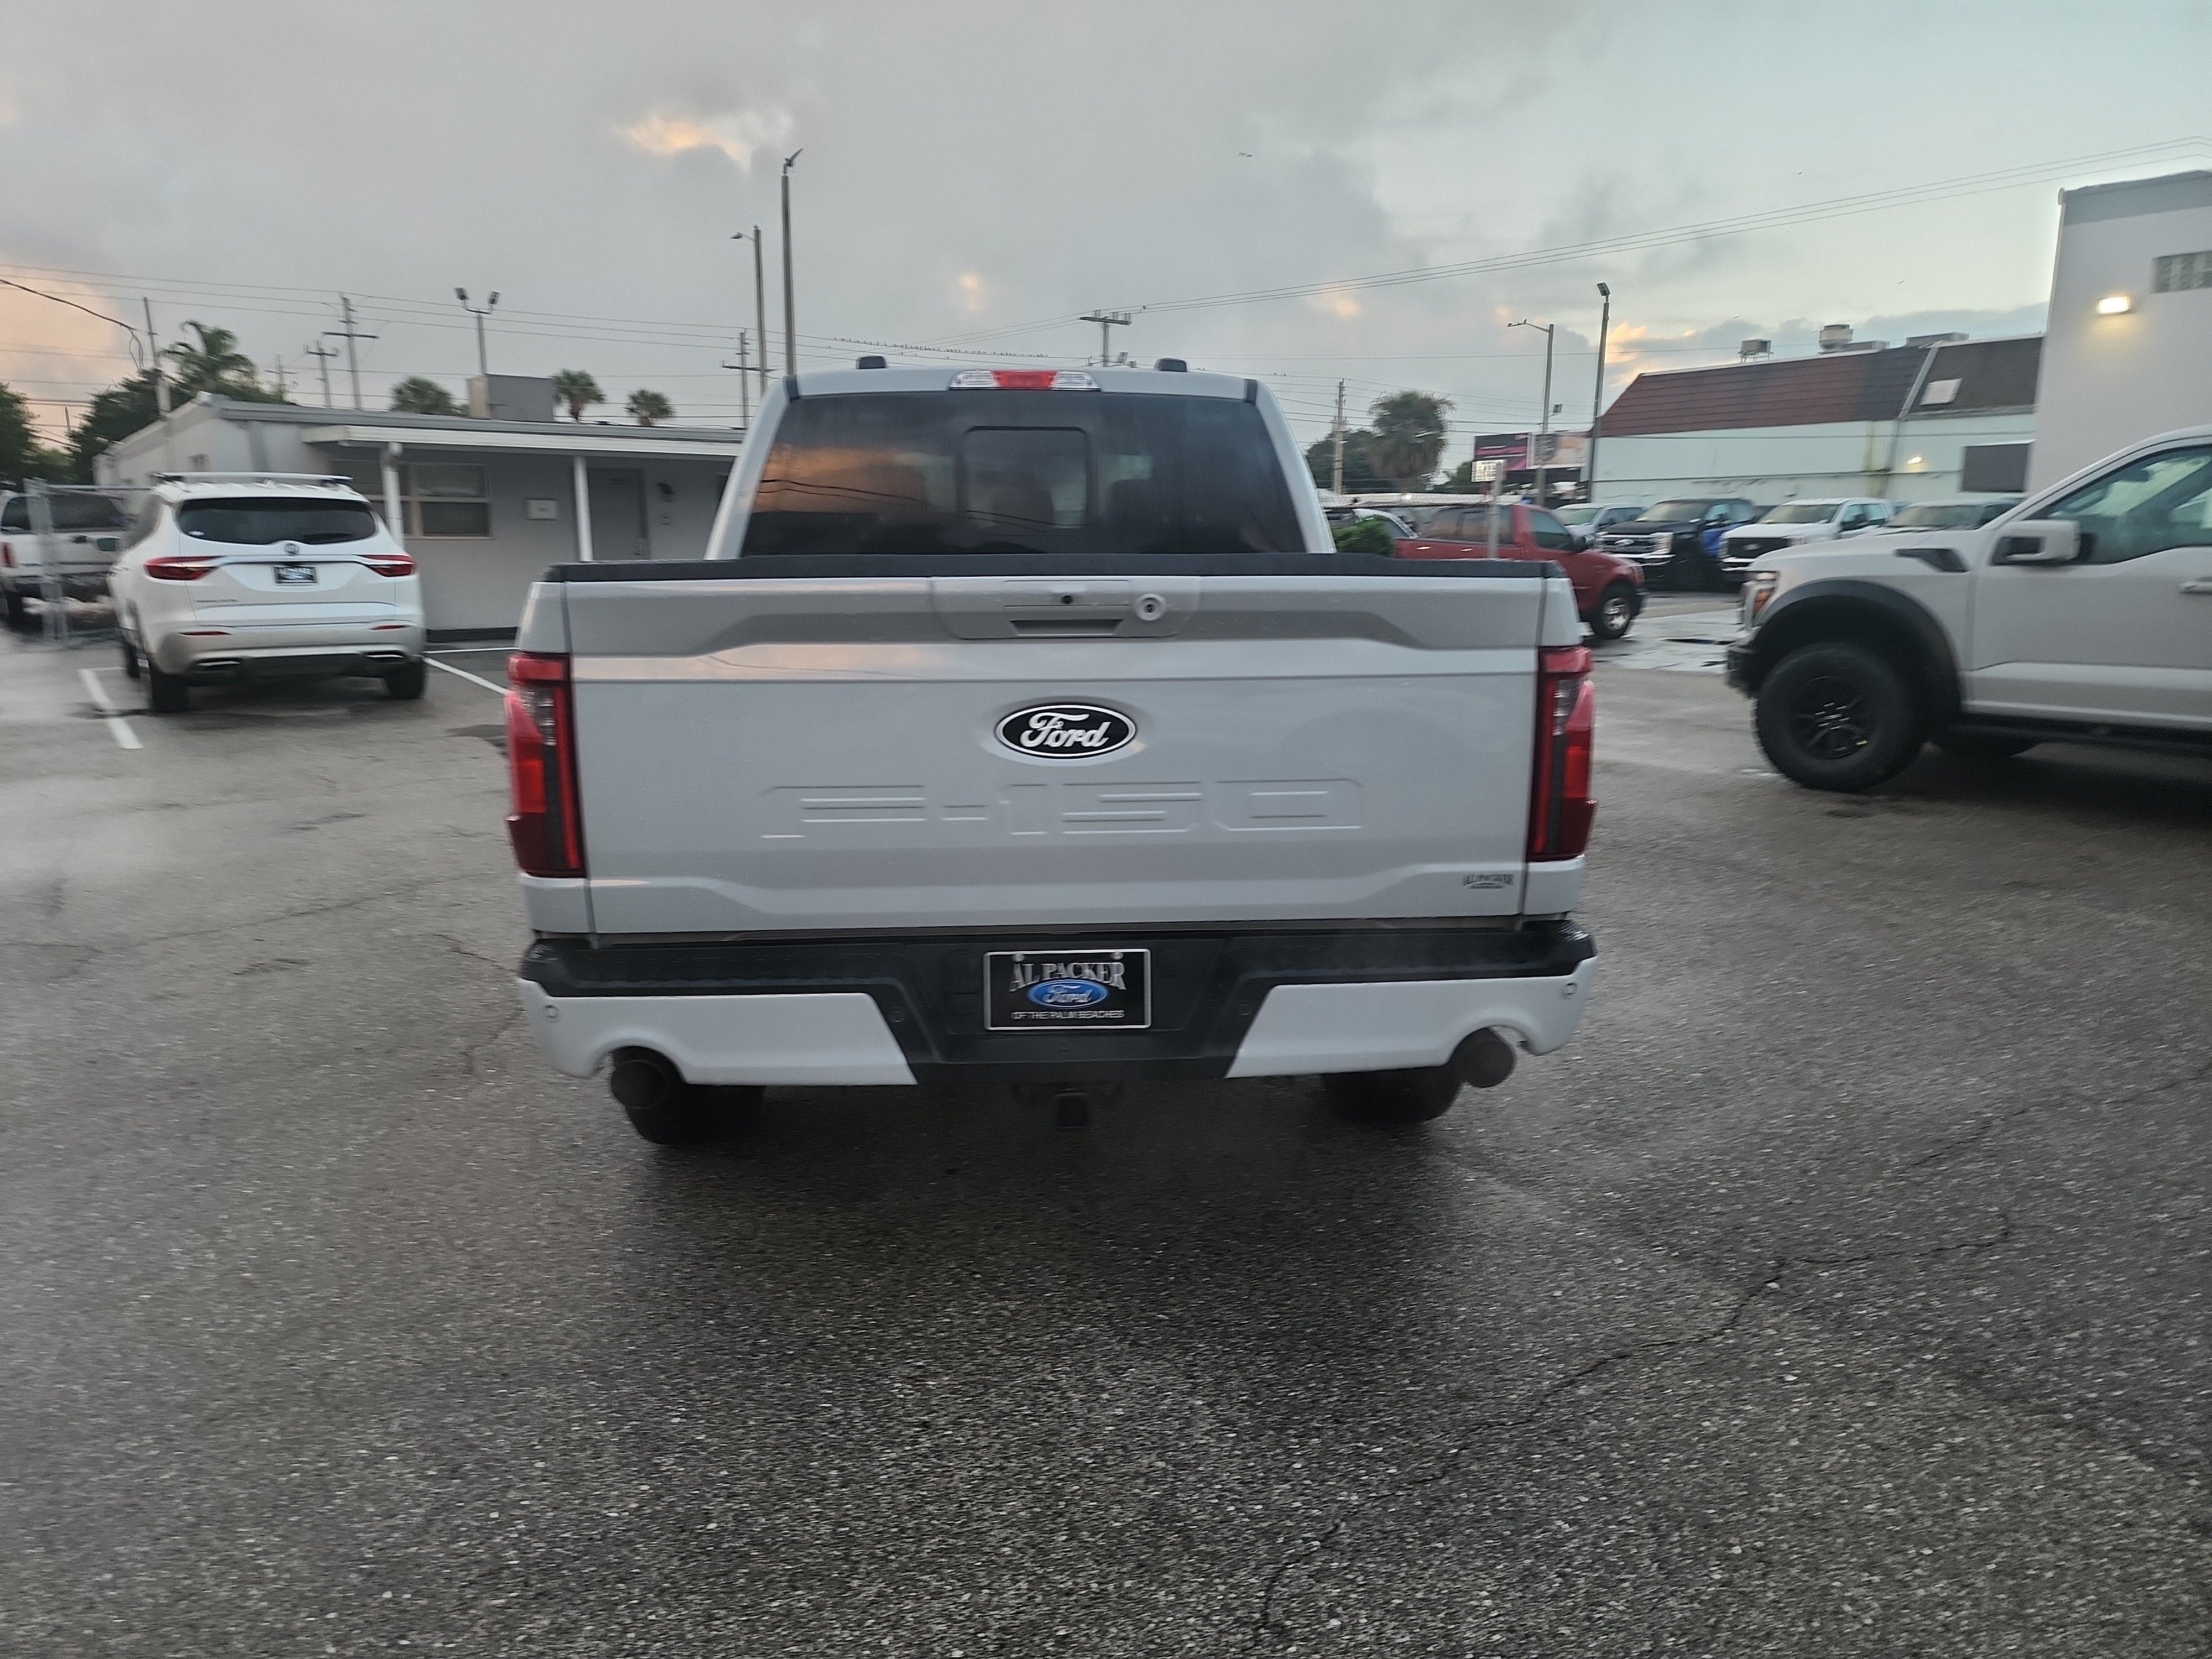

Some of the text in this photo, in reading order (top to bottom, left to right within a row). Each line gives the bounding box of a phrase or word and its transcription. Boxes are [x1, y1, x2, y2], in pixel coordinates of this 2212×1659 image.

[1020, 712, 1112, 747] Ford
[1008, 962, 1127, 993] AL PACKER
[1044, 984, 1093, 1003] Ford
